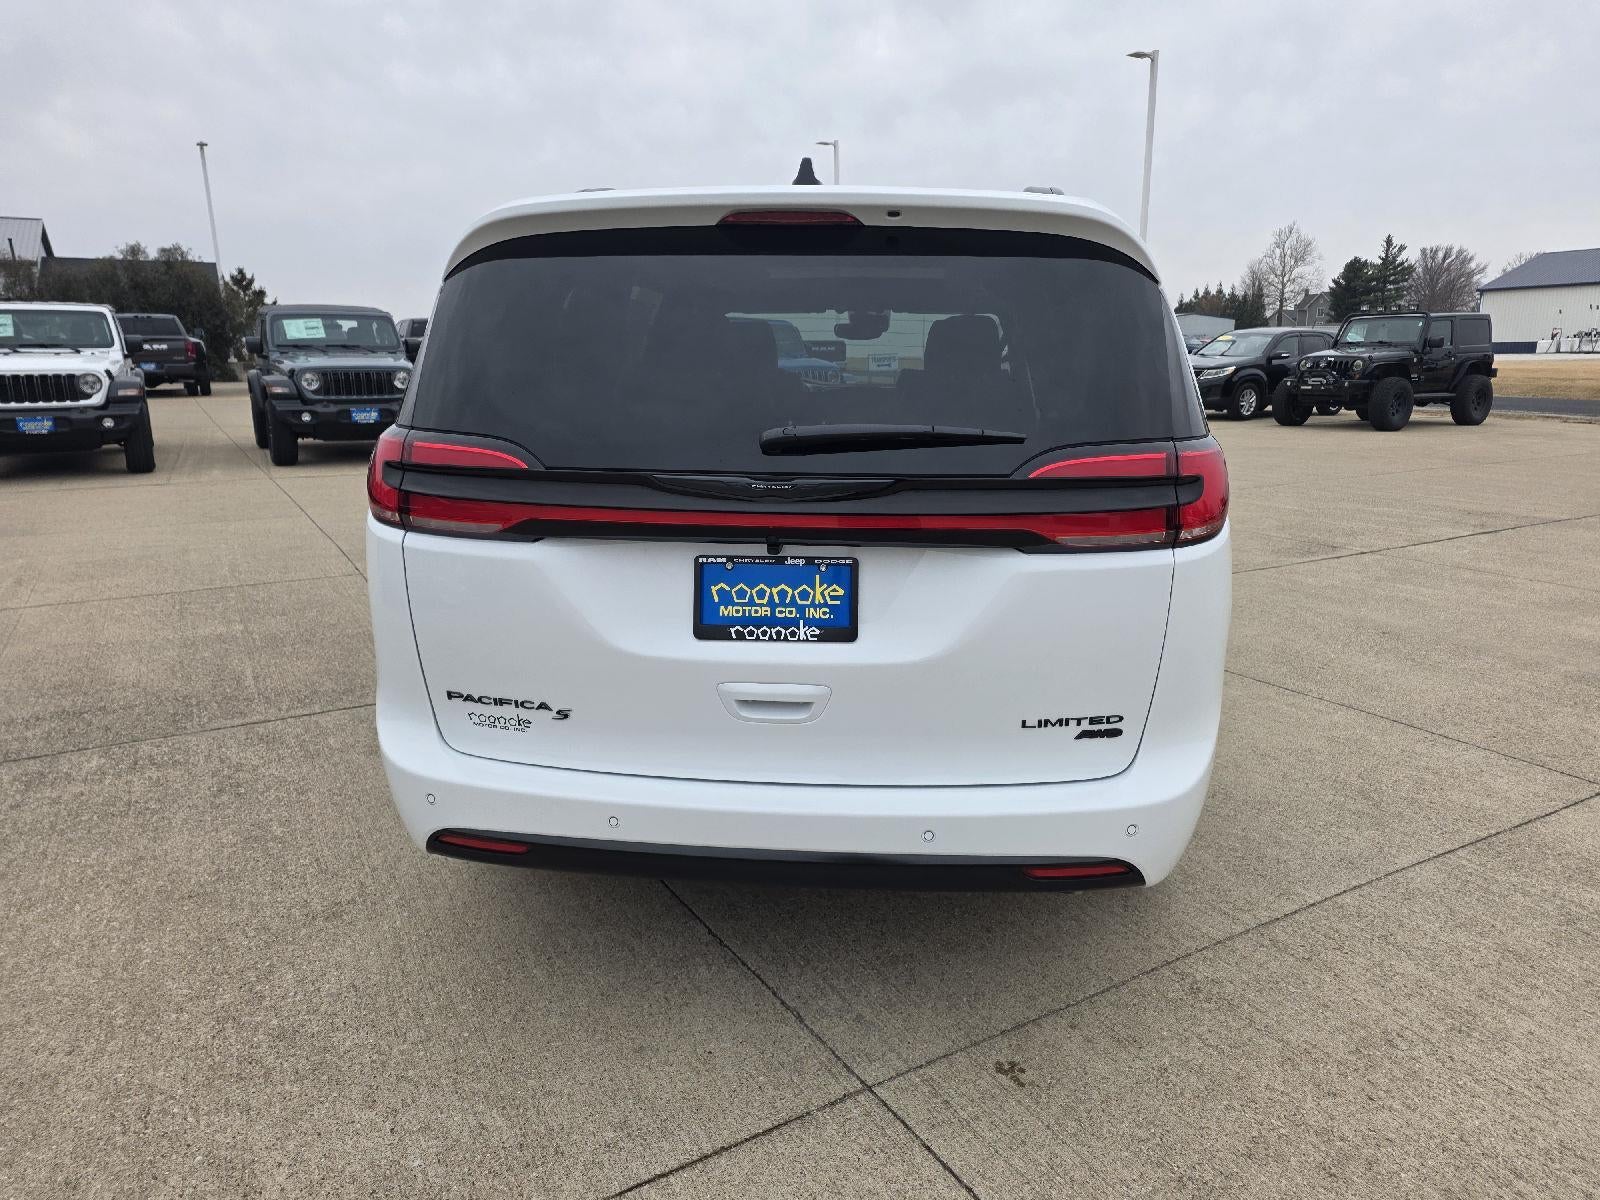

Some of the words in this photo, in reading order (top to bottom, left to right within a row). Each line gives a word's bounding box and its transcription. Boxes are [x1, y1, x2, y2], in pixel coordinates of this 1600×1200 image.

[785, 556, 806, 566] Jeep
[719, 605, 771, 617] MOTOR
[775, 606, 800, 618] CO.
[805, 607, 834, 619] INC.
[446, 690, 553, 712] PACIFICA
[551, 708, 573, 721] S
[1021, 714, 1124, 729] LIMITED
